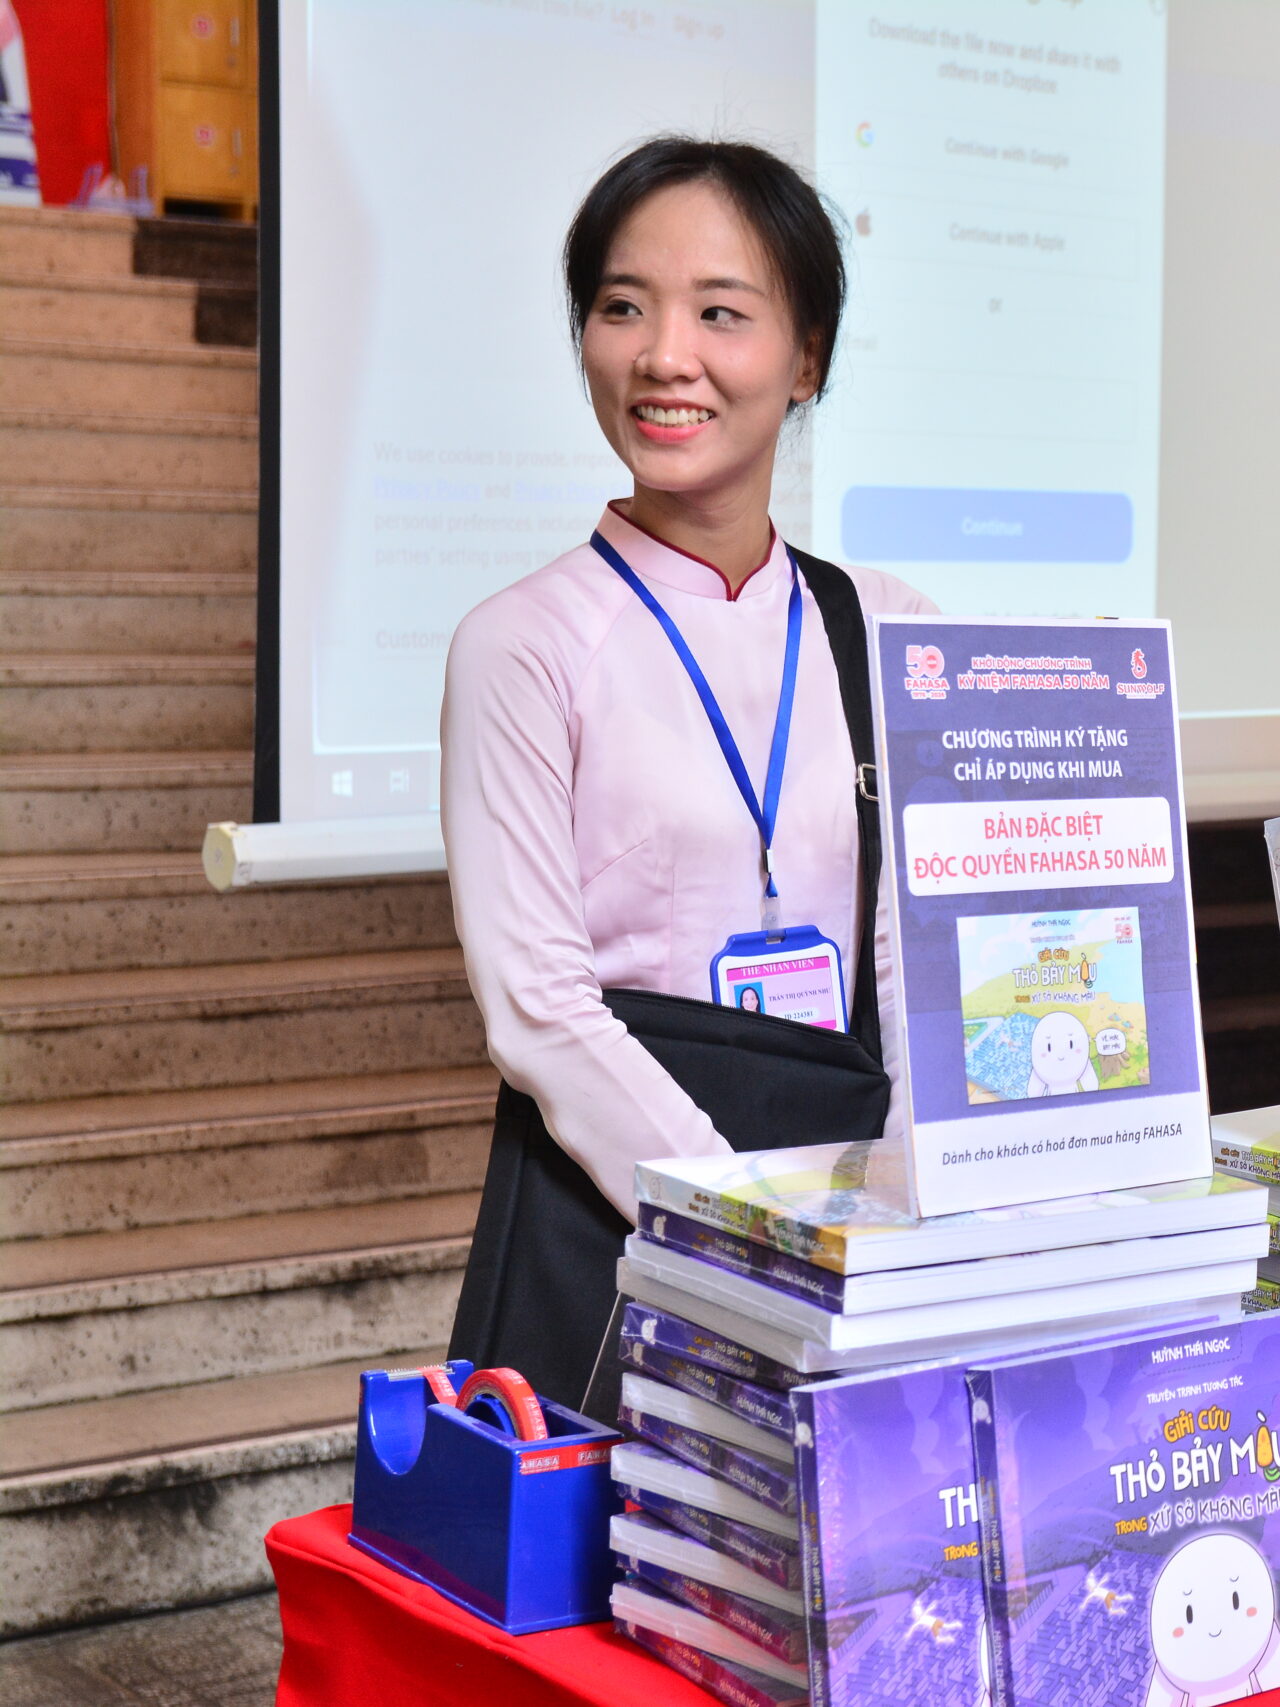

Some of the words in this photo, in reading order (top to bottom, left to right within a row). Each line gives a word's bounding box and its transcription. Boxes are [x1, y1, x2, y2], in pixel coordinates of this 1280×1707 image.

[972, 654, 996, 669] KHỞI
[997, 655, 1024, 672] ĐỘNG
[1025, 656, 1064, 670] CHƯƠNG
[1065, 656, 1092, 670] TRÌNH
[905, 677, 950, 690] FAHASA
[978, 672, 1010, 693] NIỆM
[1012, 673, 1063, 690] FAHASA
[1064, 674, 1080, 689] 50
[1117, 683, 1165, 695] SUNWOLF
[942, 728, 1013, 749] CHƯƠNG
[1014, 726, 1061, 748] TRÌNH
[1065, 725, 1085, 747] KÝ
[1087, 725, 1128, 752] TẶNG
[954, 757, 981, 781] CHỈ
[985, 758, 1006, 780] ÁP
[1010, 761, 1055, 784] DỤNG
[1058, 761, 1085, 778] KHI
[1088, 760, 1123, 777] MUA
[984, 811, 1022, 839] BẢN
[1025, 813, 1062, 843] ĐẶC
[1066, 810, 1103, 841] BIỆT
[913, 852, 958, 884] ĐỘC
[1029, 849, 1100, 873] FAHASA
[1104, 849, 1124, 869] 50
[1127, 843, 1167, 868] NĂM
[942, 1150, 972, 1166] Dành
[974, 1148, 994, 1162] cho
[997, 1142, 1029, 1159] khách
[1031, 1139, 1044, 1154] có
[1046, 1136, 1066, 1152] hoá
[1068, 1135, 1088, 1149] đơn
[1090, 1133, 1113, 1146] mua
[1115, 1129, 1140, 1145] hàng
[1143, 1123, 1182, 1140] FAHASA
[1151, 1346, 1183, 1364] HUỲNH
[1147, 1388, 1176, 1404] TRUYỆN
[1177, 1384, 1202, 1399] TRANH
[1229, 1375, 1244, 1387] TÁC
[1197, 1404, 1232, 1432] CỨU
[1109, 1448, 1166, 1504] THỎ
[1171, 1436, 1223, 1491] BẢY
[1114, 1517, 1148, 1536] TRONG
[1148, 1503, 1172, 1535] XỨ
[1175, 1498, 1196, 1526] SỞ
[1198, 1495, 1253, 1522] KHÔNG
